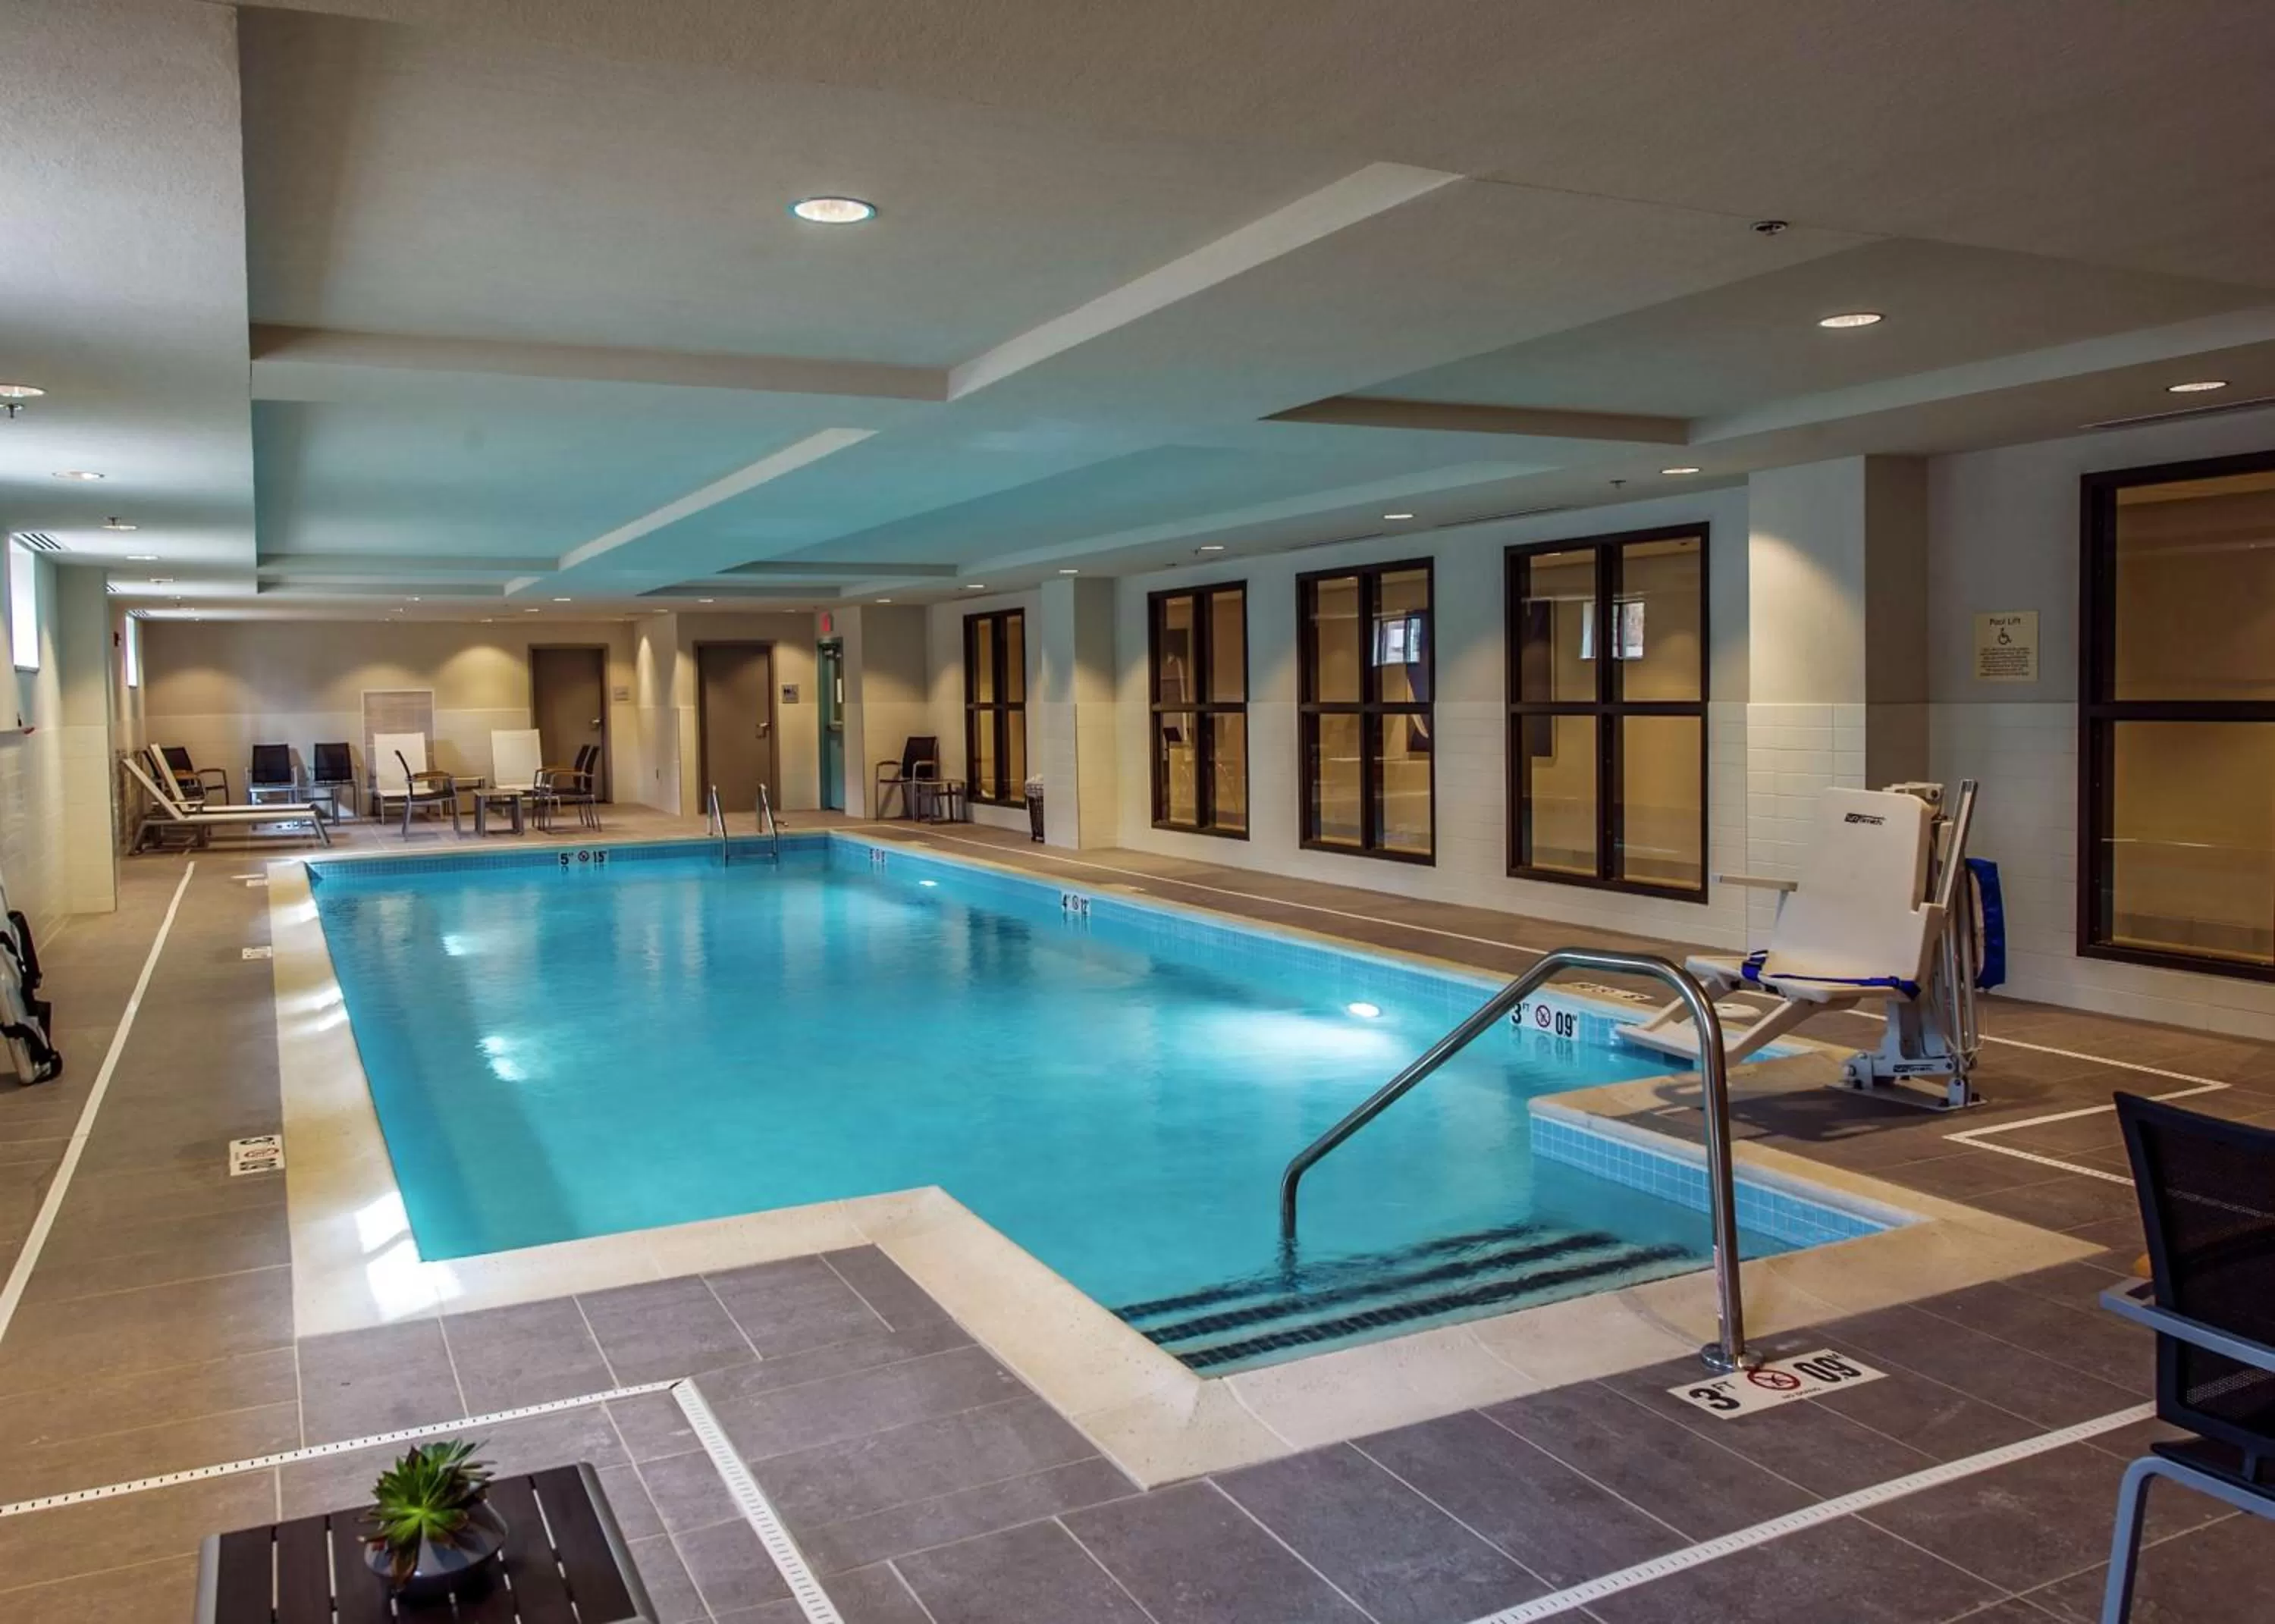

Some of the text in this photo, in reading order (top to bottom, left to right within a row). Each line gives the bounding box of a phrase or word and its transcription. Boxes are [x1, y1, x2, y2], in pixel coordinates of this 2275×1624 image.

[560, 852, 569, 865] 5
[1511, 1003, 1522, 1024] 3
[1688, 1387, 1740, 1410] 3
